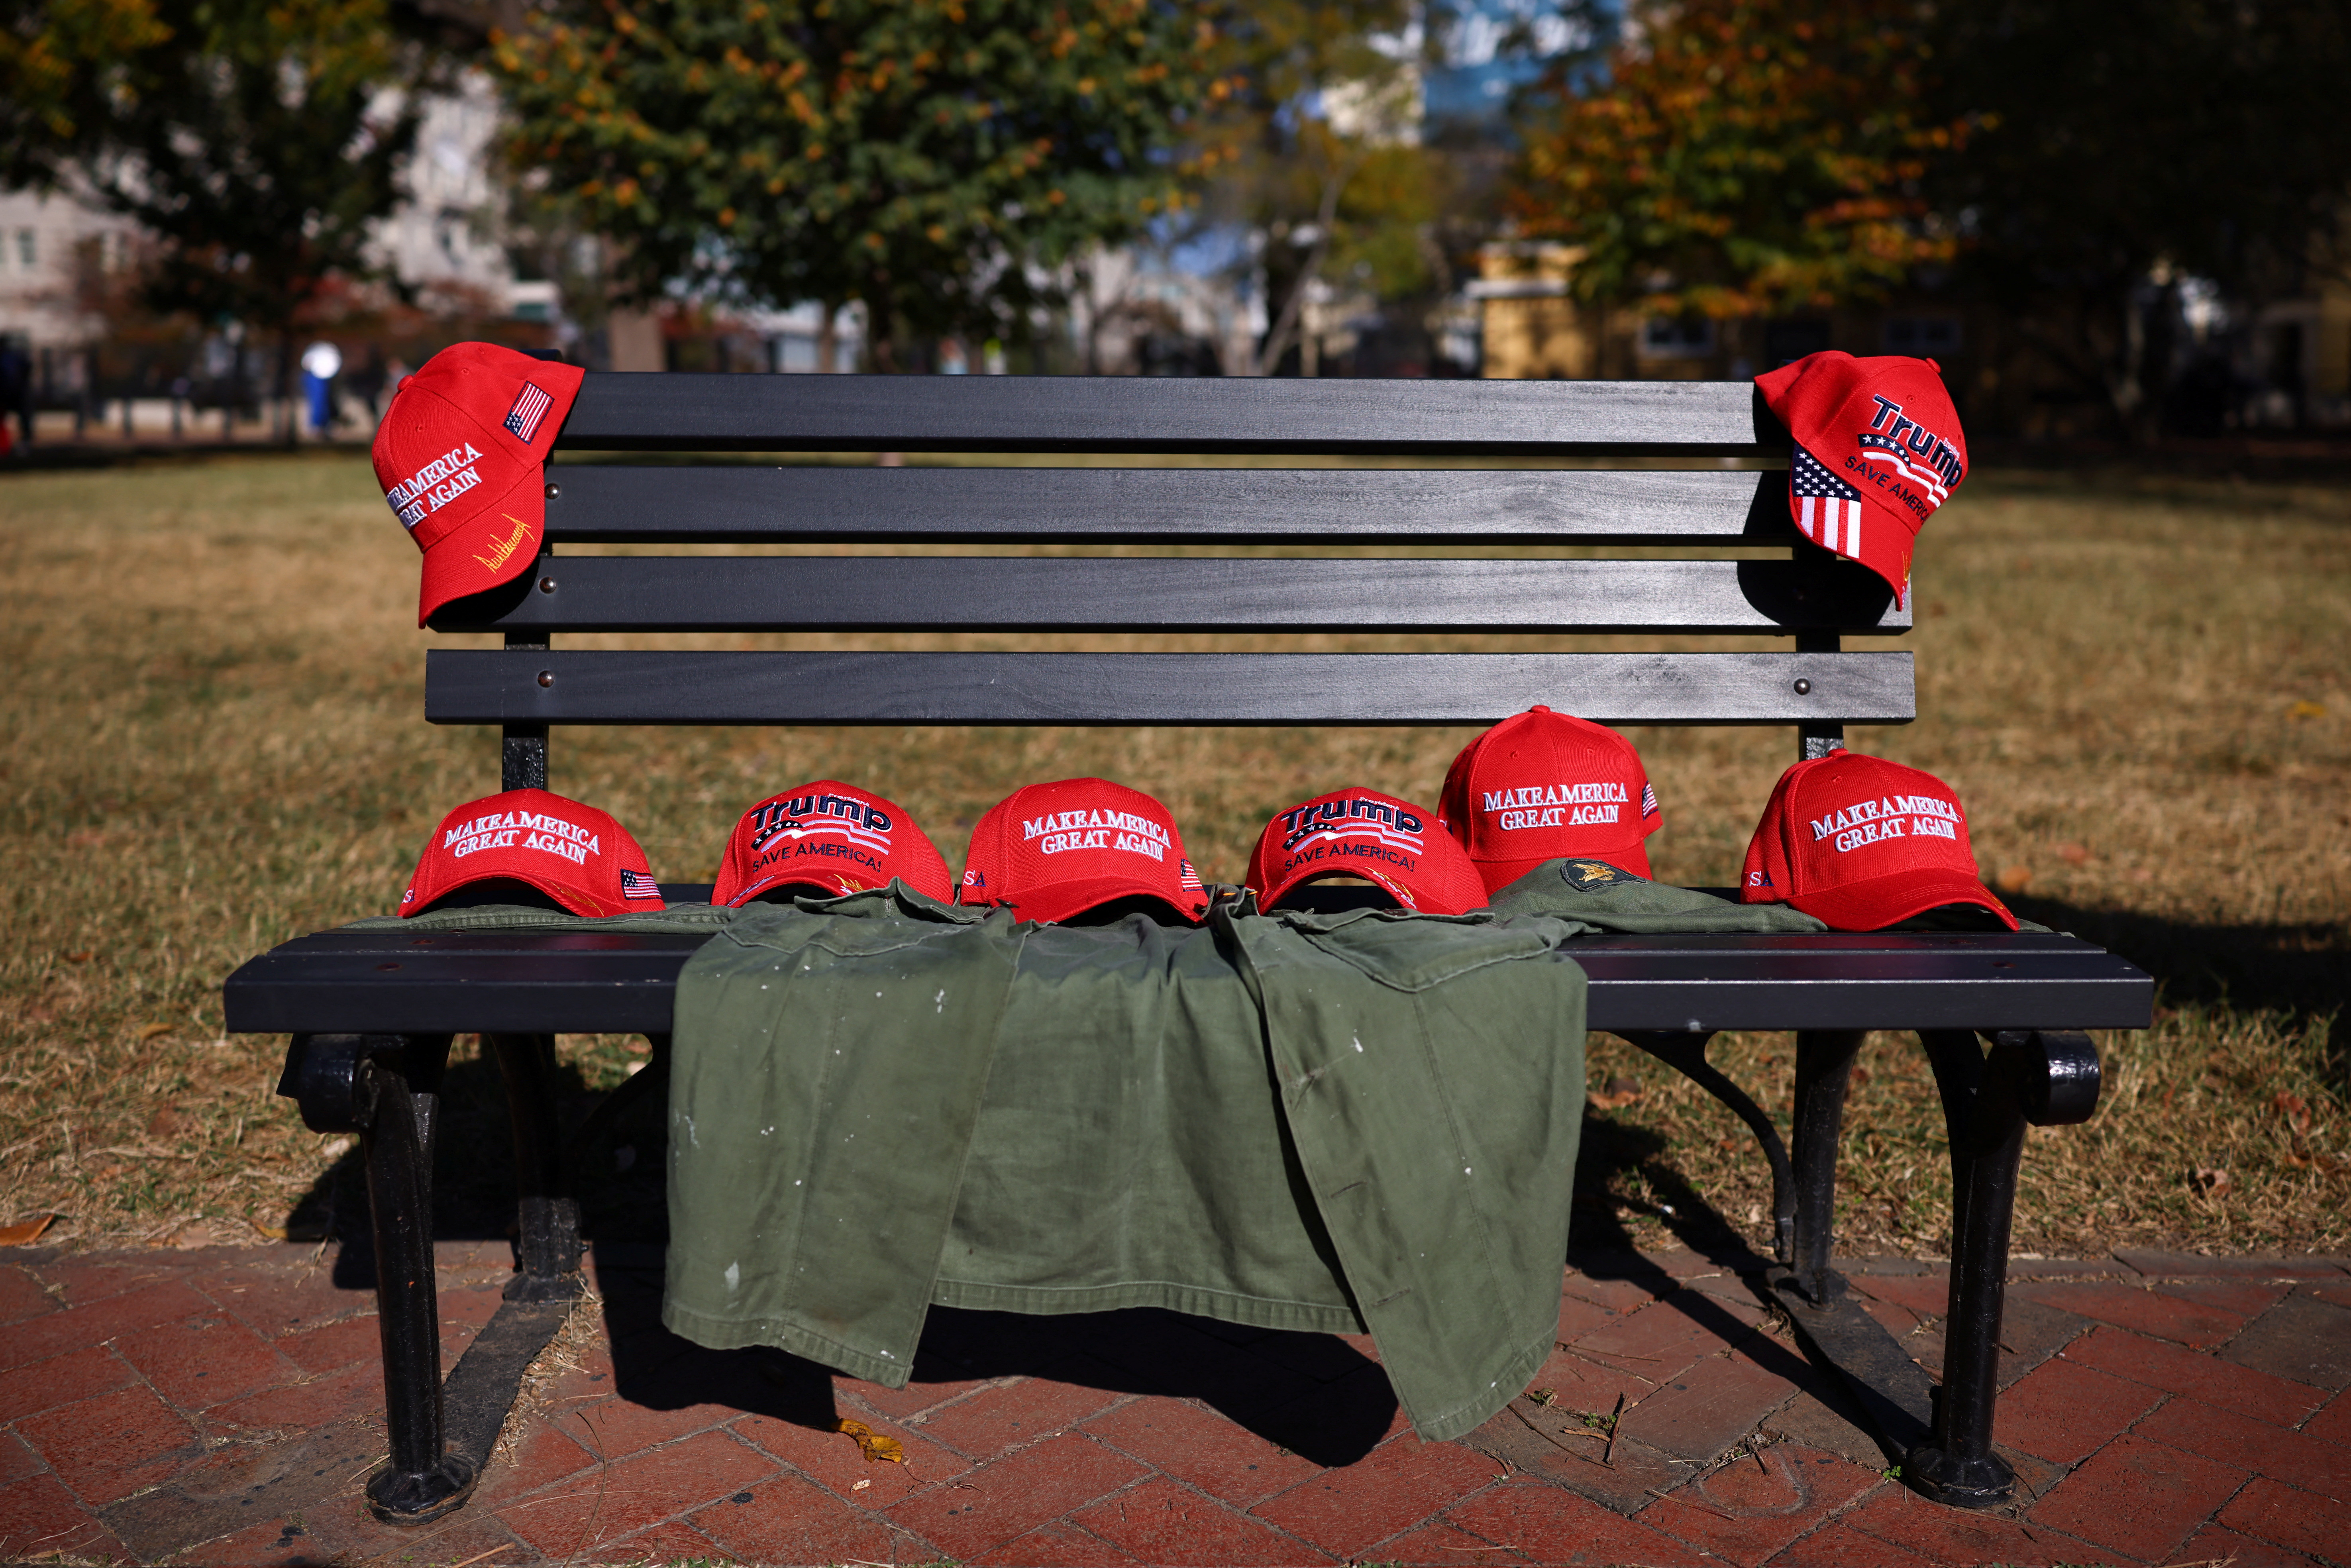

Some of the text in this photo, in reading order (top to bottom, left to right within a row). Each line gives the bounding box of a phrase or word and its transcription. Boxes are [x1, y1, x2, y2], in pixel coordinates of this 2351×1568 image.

[1870, 393, 1962, 488] Trump
[427, 466, 482, 512] AGAIN
[1845, 455, 1890, 488] SAVE
[751, 795, 893, 832] Trump
[1281, 799, 1424, 834] Trump
[1500, 805, 1619, 830] GREAT AGAIN
[454, 830, 588, 865] GREAT AGAIN
[1041, 830, 1164, 862] GREAT AGAIN
[1835, 817, 1957, 853] GREAT AGAIN
[753, 842, 882, 873] SAVE AMERICA!
[1285, 844, 1415, 872] SAVE AMERICA!
